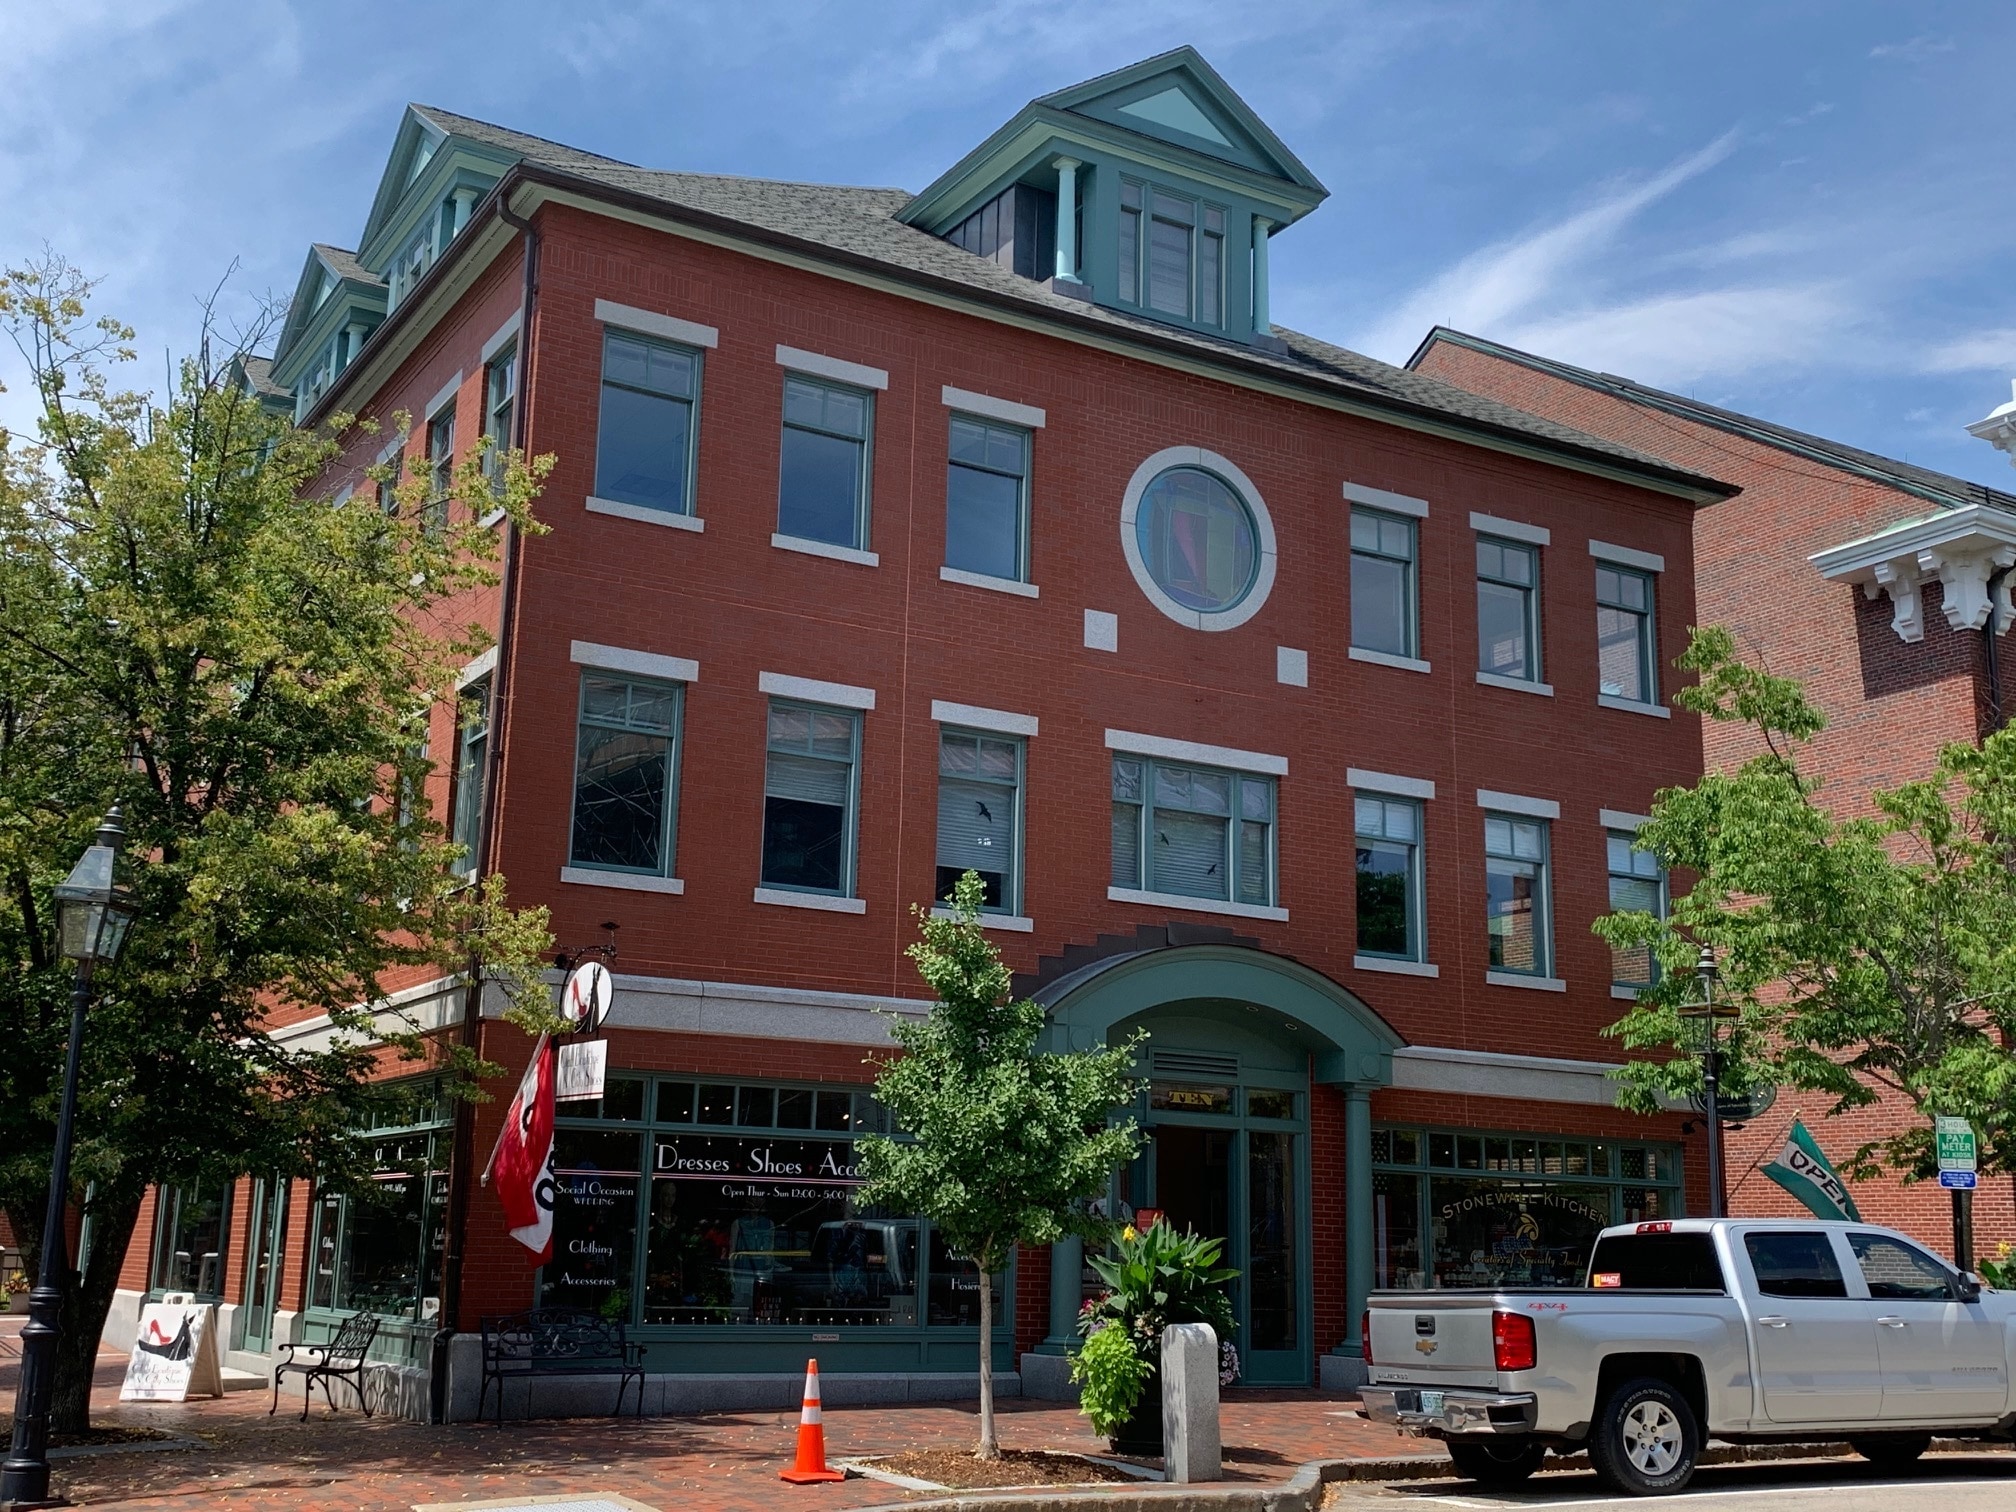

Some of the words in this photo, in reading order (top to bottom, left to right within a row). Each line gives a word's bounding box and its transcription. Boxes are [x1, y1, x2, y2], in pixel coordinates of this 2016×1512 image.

[1169, 1090, 1214, 1105] TEN
[1940, 1118, 1946, 1128] 3
[1941, 1142, 1971, 1151] METER
[1946, 1134, 1965, 1143] PAY
[658, 1144, 730, 1172] Dresses
[747, 1147, 802, 1175] Shoes
[555, 1180, 587, 1195] Social
[588, 1181, 635, 1197] Occasion
[721, 1184, 745, 1198] Open
[748, 1185, 766, 1197] Thur
[773, 1185, 790, 1198] Sun
[791, 1188, 817, 1199] 12:00
[823, 1189, 845, 1200] 5:00
[1442, 1191, 1538, 1219] STONEWALL
[1543, 1191, 1609, 1227] KITCHEN
[568, 1239, 613, 1257] Clothing
[1519, 1249, 1556, 1269] Specialty
[560, 1271, 617, 1286] Accessories
